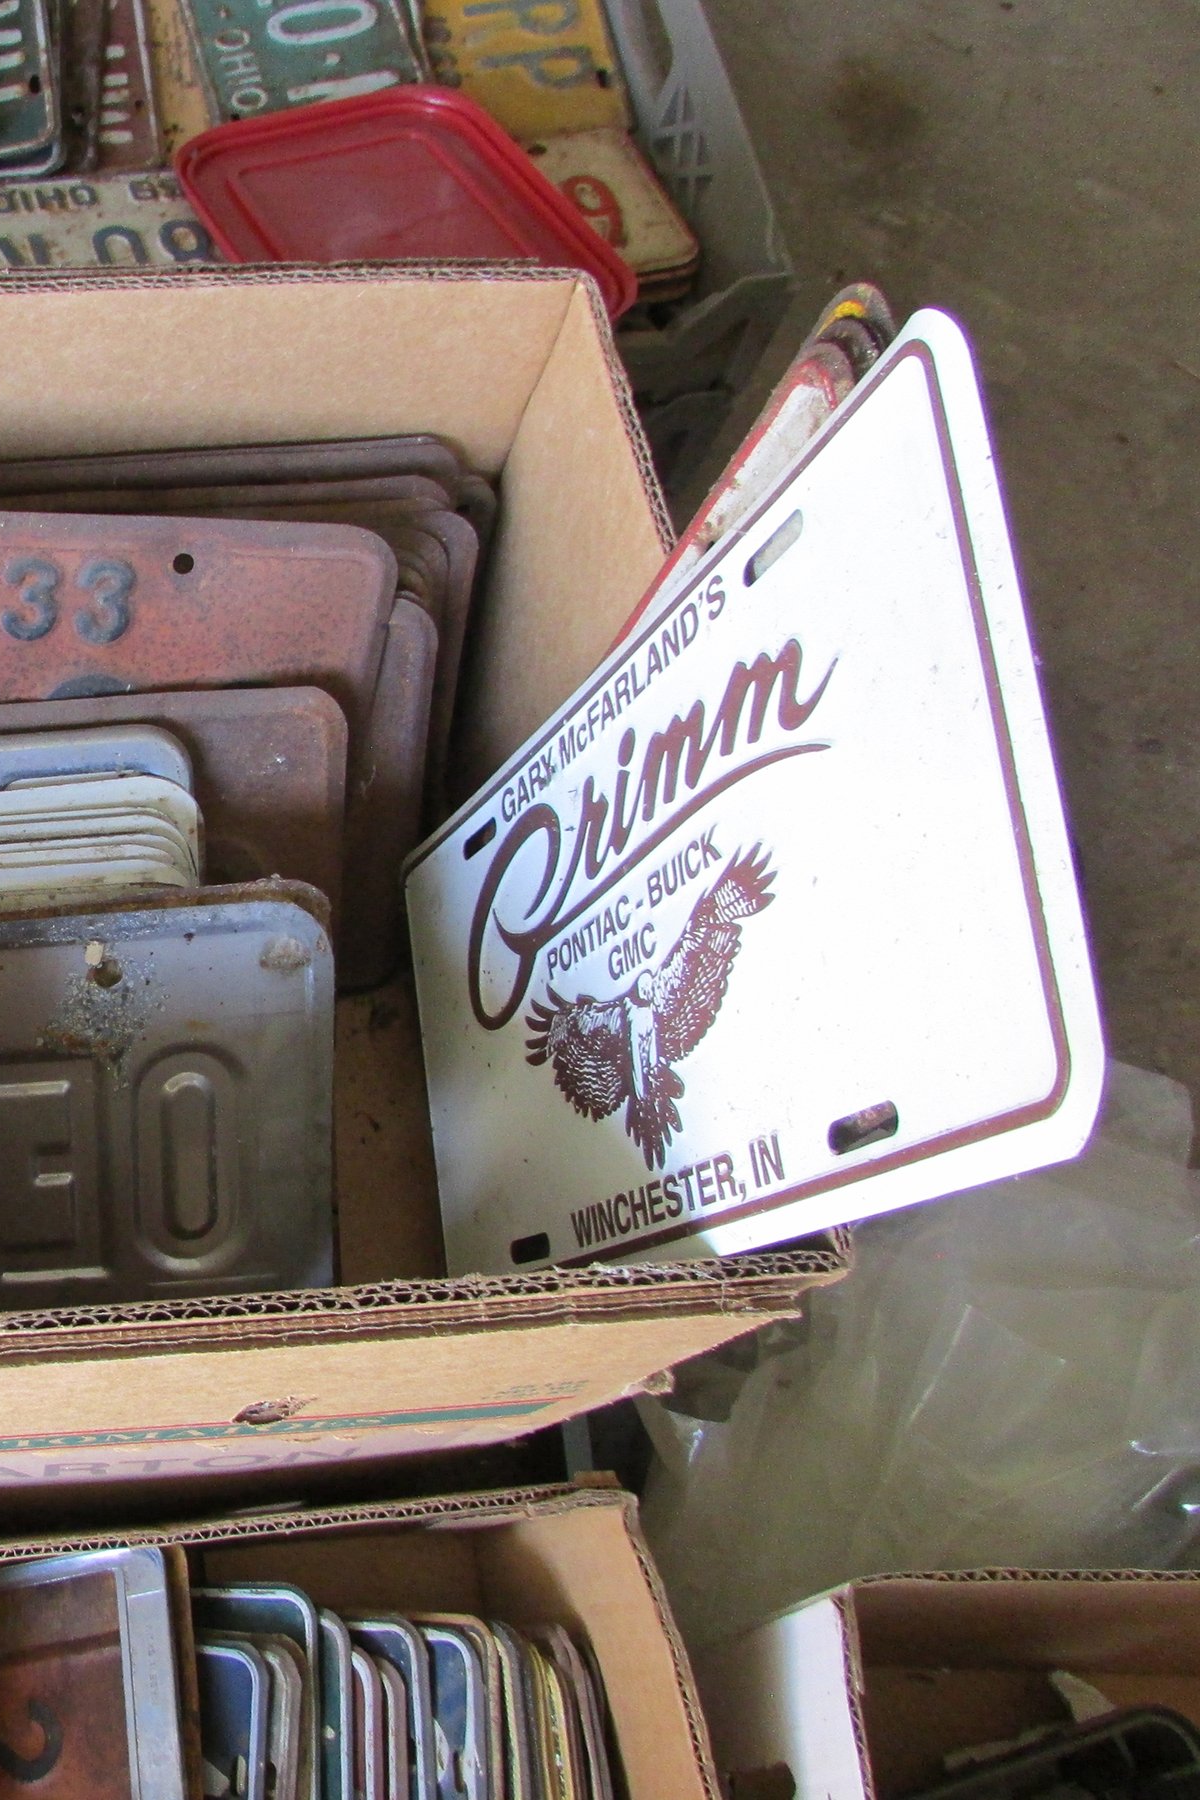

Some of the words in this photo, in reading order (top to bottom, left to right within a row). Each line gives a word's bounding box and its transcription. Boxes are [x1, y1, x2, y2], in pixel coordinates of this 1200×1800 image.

[501, 755, 558, 822] GARY
[546, 896, 631, 980] PONTIAC
[647, 832, 723, 907] BUICK
[608, 922, 658, 981] GMC
[571, 1152, 747, 1249] WINCHESTER,
[749, 1134, 786, 1188] IN
